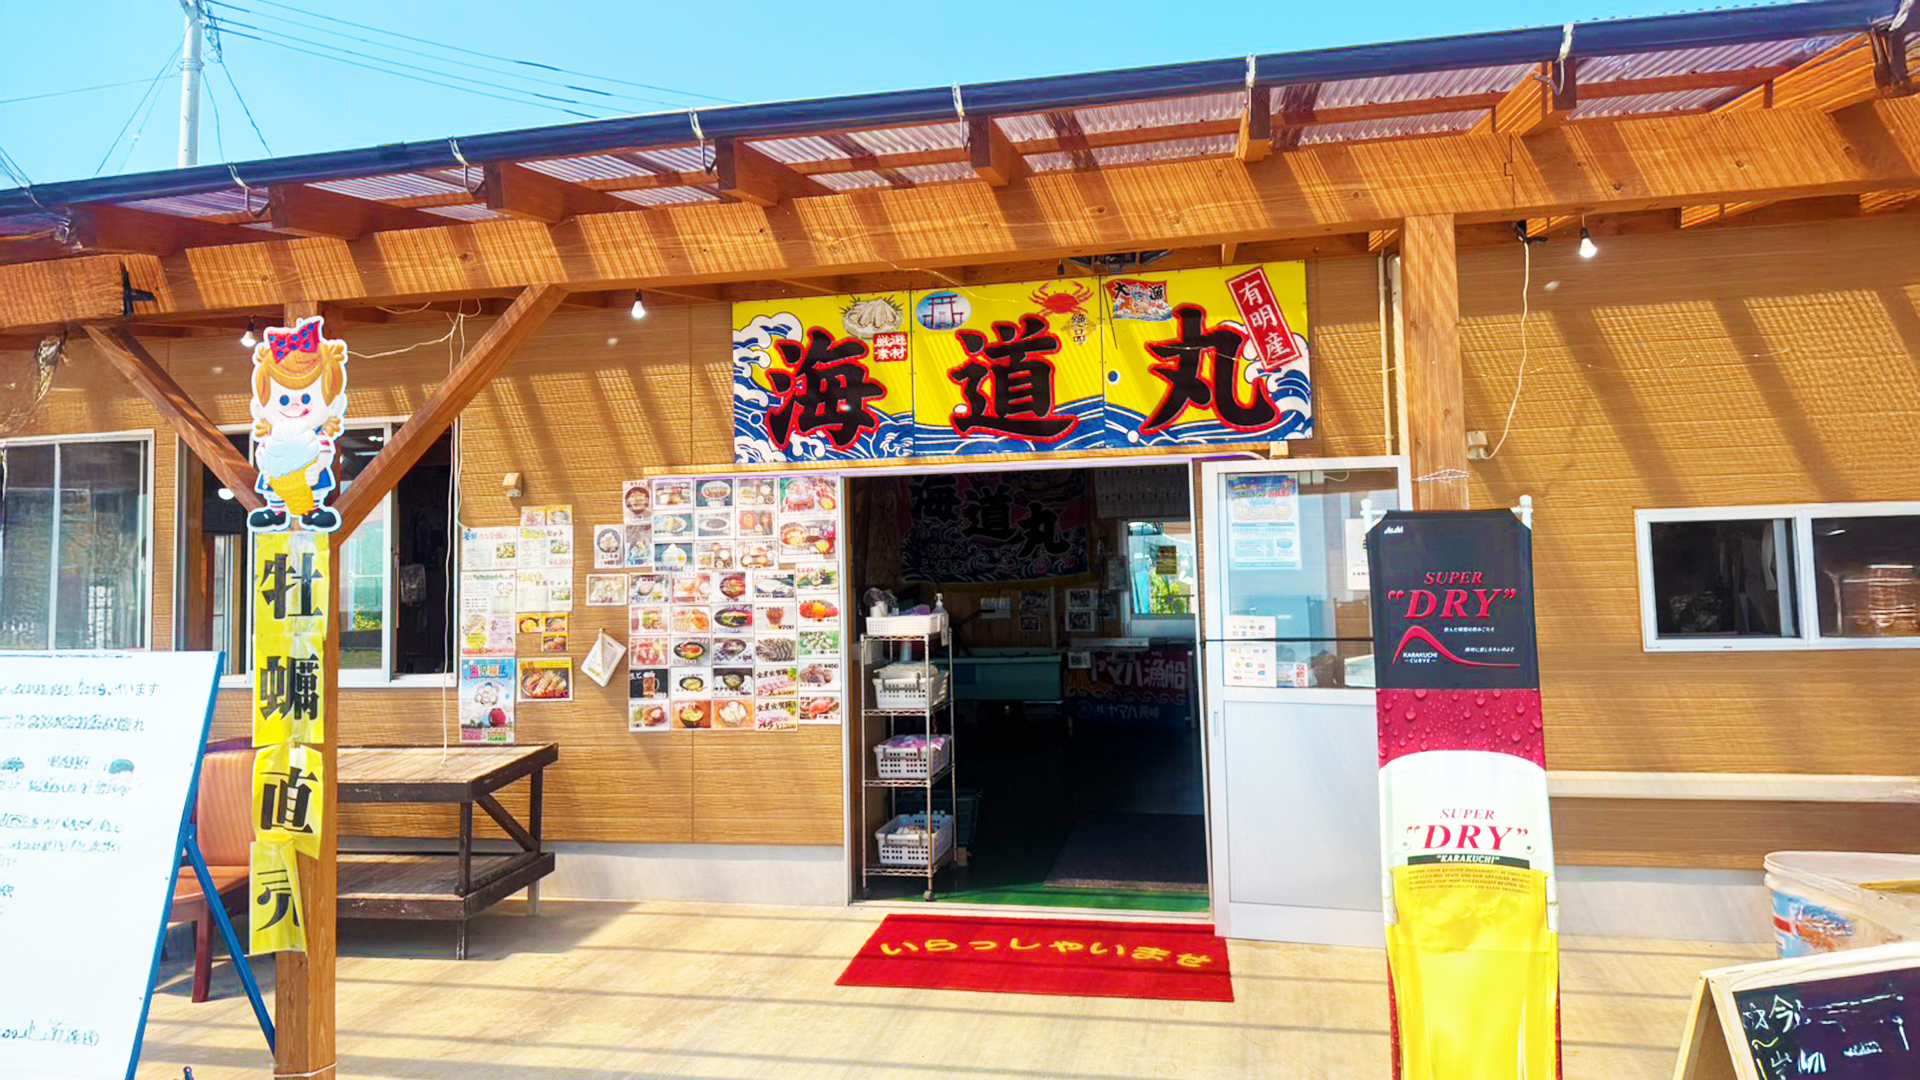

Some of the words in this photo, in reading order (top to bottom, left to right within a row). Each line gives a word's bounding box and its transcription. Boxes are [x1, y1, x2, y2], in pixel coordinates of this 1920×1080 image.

[1238, 280, 1291, 361] 有明産
[767, 304, 1280, 449] 海道丸
[1384, 526, 1404, 535] Asahi
[1424, 571, 1484, 586] SUPER
[1439, 808, 1496, 821] SUPER
[881, 938, 1211, 968] いらっしゃいませ
